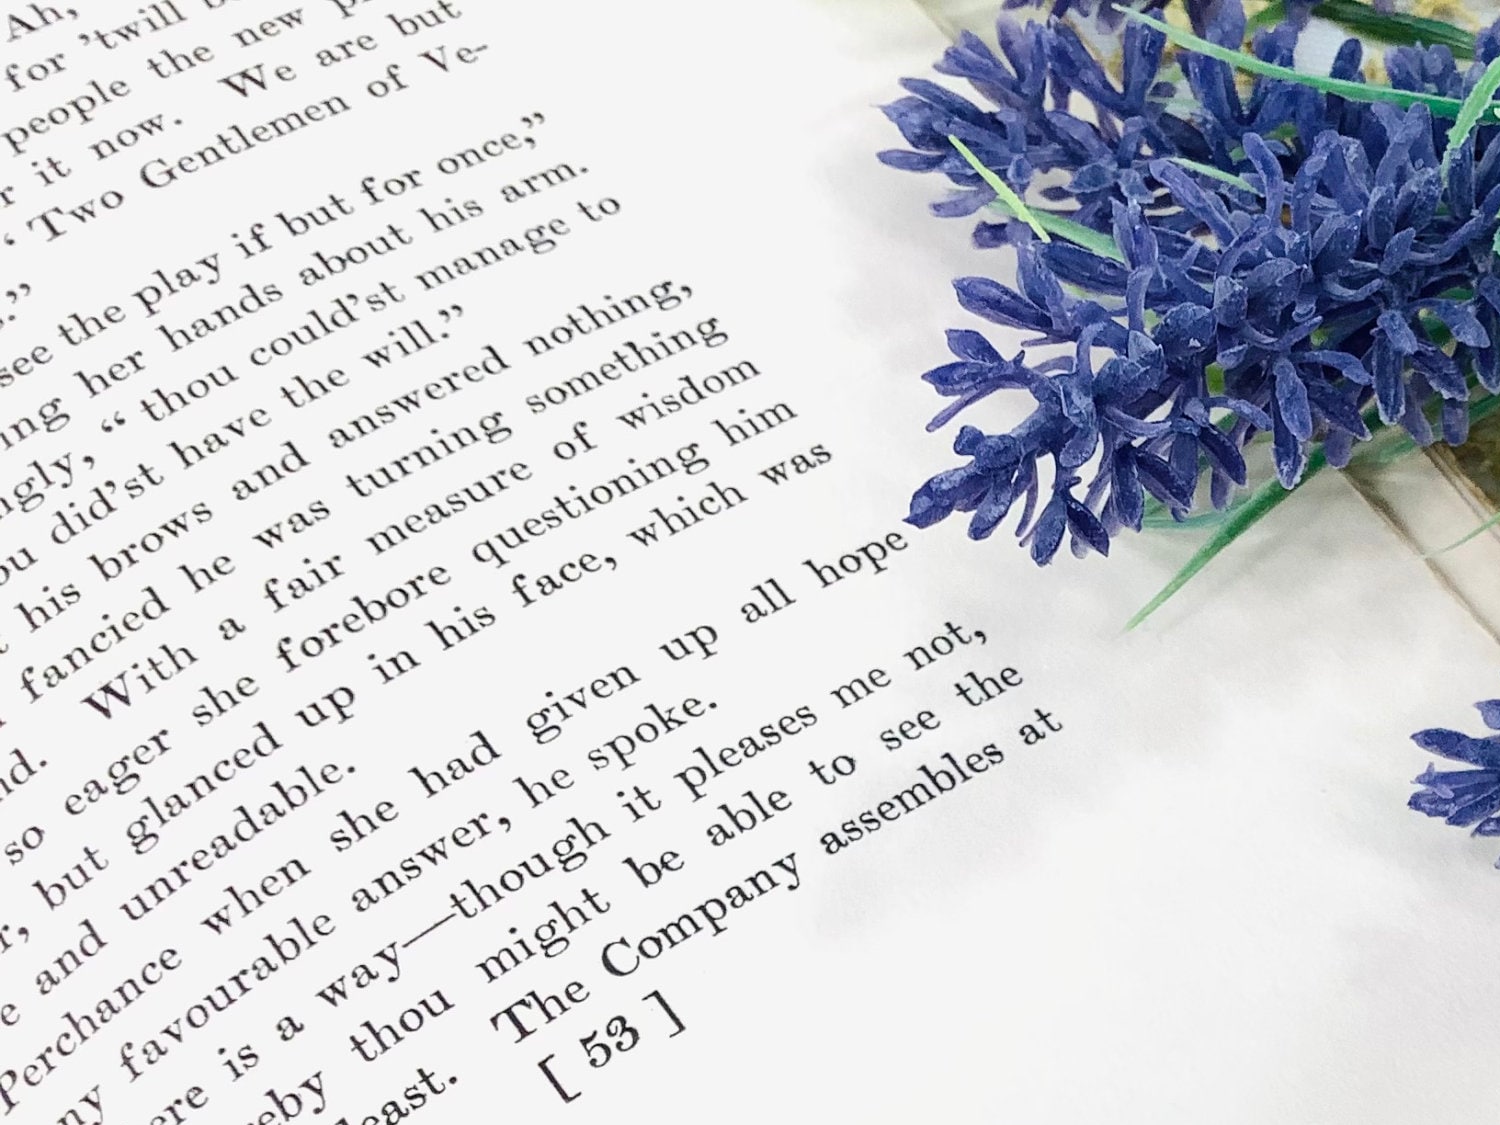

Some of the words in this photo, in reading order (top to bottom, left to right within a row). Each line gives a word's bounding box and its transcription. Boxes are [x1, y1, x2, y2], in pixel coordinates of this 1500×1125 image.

[2, 81, 129, 154] people
[147, 47, 213, 78] the
[232, 9, 302, 46] new
[6, 54, 65, 92] for
[9, 4, 78, 41] Ah,
[32, 158, 71, 186] it
[90, 114, 182, 160] now.
[218, 64, 296, 97] We
[316, 36, 377, 66] are
[386, 0, 461, 36] but
[140, 97, 350, 188] Gentlemen
[367, 64, 407, 97] of
[418, 45, 487, 72] Ve-
[0, 346, 52, 387] see
[58, 306, 125, 346] the
[132, 253, 219, 317] play
[231, 223, 272, 258] if
[274, 195, 353, 236] but
[362, 170, 421, 205] for
[73, 351, 145, 398] her
[156, 284, 283, 352] hands
[299, 224, 412, 286] about
[418, 198, 483, 232] his
[501, 164, 588, 203] arm.
[250, 282, 404, 366] could’st
[415, 219, 566, 290] manage
[577, 198, 620, 221] to
[14, 584, 81, 633] his
[87, 502, 212, 581] brows
[232, 441, 310, 500] and
[329, 345, 511, 448] answered
[523, 281, 692, 355] nothing,
[21, 586, 170, 704] fancied
[178, 556, 235, 592] he
[252, 500, 330, 548] was
[346, 412, 512, 497] turning
[526, 318, 728, 414] something
[51, 464, 164, 544] did’st
[167, 409, 271, 469] have
[281, 370, 349, 408] the
[81, 644, 198, 719] With
[219, 618, 246, 640] a
[265, 555, 344, 613] fair
[366, 463, 532, 554] measure
[553, 421, 597, 460] of
[616, 361, 760, 429] wisdom
[5, 826, 44, 865] so
[65, 729, 171, 815] eager
[193, 677, 259, 727] she
[277, 567, 451, 672] forebore
[472, 443, 710, 568] questioning
[711, 404, 798, 446] him
[32, 847, 108, 910] but
[127, 721, 283, 855] glanced
[295, 687, 355, 727] up
[368, 651, 421, 684] in
[424, 606, 496, 651] his
[512, 554, 617, 607] face,
[626, 482, 748, 546] which
[759, 444, 832, 485] was
[0, 949, 182, 1115] Perchance
[200, 859, 311, 934] when
[330, 802, 399, 852] she
[408, 730, 501, 798] had
[527, 667, 641, 744] given
[659, 626, 718, 660] up
[741, 578, 796, 623] all
[802, 533, 908, 588] hope
[36, 919, 108, 995] and
[120, 764, 355, 920] unreadable.
[121, 915, 335, 1082] favourable
[352, 813, 511, 912] answer,
[512, 770, 574, 808] he
[588, 698, 717, 771] spoke.
[218, 1045, 259, 1081] is
[276, 1016, 304, 1041] a
[617, 786, 661, 822] it
[673, 706, 817, 802] pleases
[830, 669, 891, 708] me
[903, 622, 987, 670] not,
[350, 990, 455, 1061] thou
[475, 888, 610, 983] might
[622, 851, 684, 888] be
[707, 791, 792, 846] able
[808, 755, 856, 785] to
[880, 711, 940, 751] see
[954, 667, 1023, 706] the
[490, 981, 590, 1043] The
[601, 852, 800, 976] Company
[820, 743, 1004, 855] assembles
[1019, 708, 1063, 745] at
